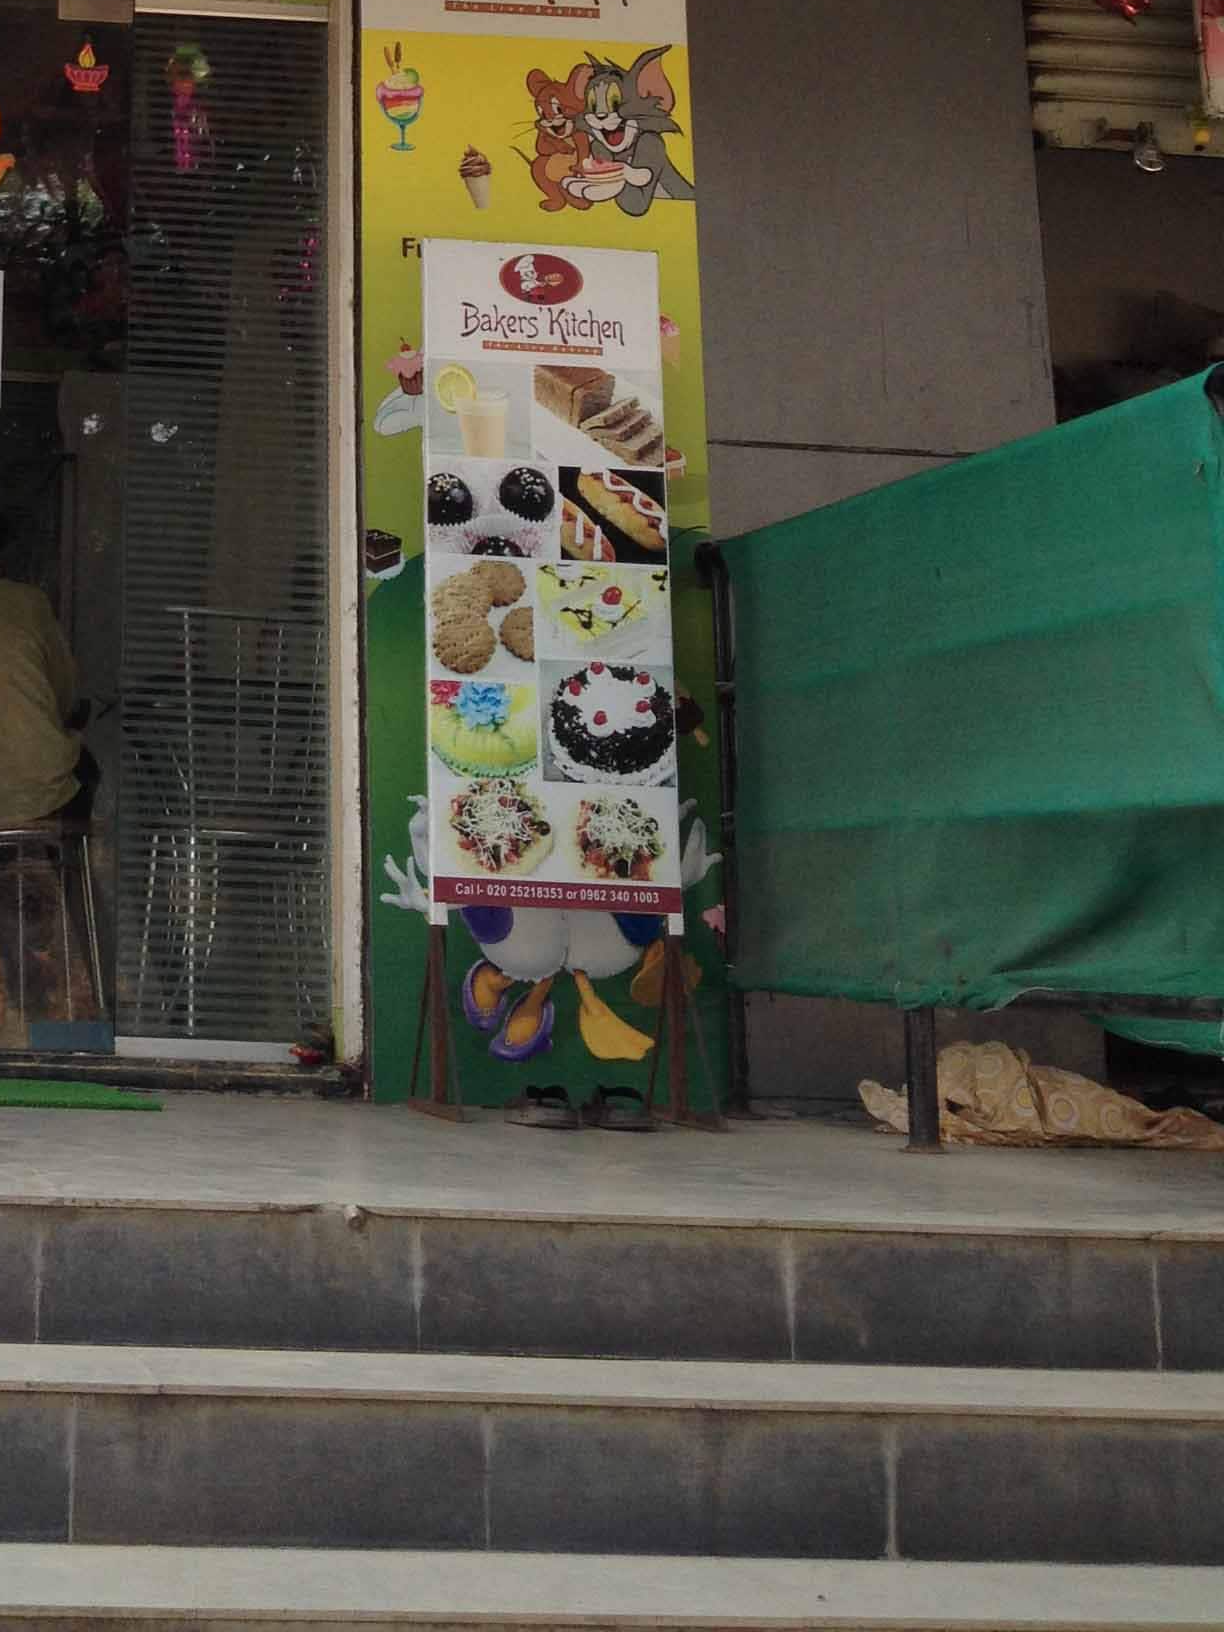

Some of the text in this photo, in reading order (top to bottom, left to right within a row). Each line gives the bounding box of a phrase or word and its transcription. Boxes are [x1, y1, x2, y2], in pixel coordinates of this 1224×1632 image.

[460, 301, 625, 346] Bakers' Kitchen
[487, 884, 507, 897] 020
[510, 885, 564, 900] 25218353
[566, 889, 577, 900] or
[610, 889, 630, 903] 340
[633, 891, 660, 904] 1003
